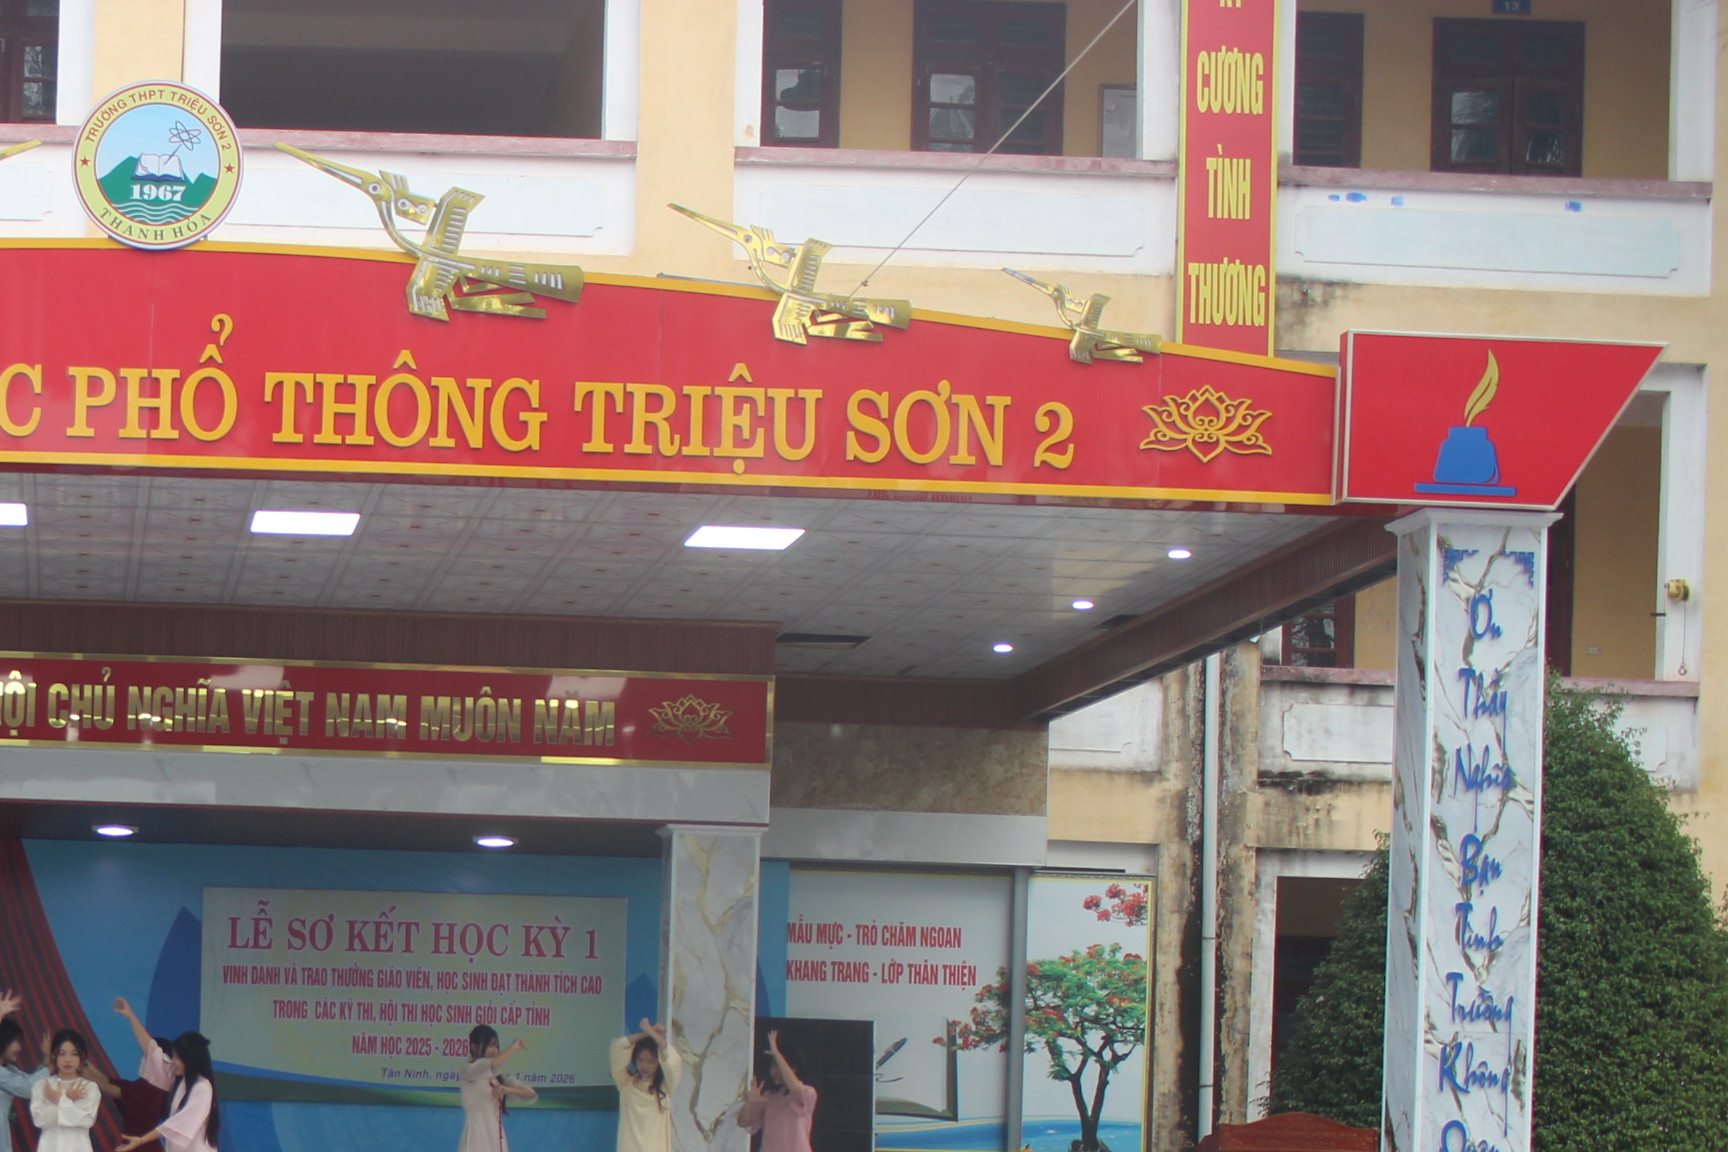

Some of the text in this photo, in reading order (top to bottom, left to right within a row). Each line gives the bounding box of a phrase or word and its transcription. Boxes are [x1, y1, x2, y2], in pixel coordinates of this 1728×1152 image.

[1196, 45, 1264, 115] CƯƠNG
[85, 89, 232, 151] TRƯỜNG THPT TRIỆU SƠN 2
[129, 183, 187, 201] 1967
[1206, 143, 1251, 220] TÌNH
[99, 207, 165, 240] THANH
[1188, 257, 1266, 327] THƯƠNG
[66, 313, 239, 442] PHỔ
[263, 349, 549, 452] THÔNG
[574, 362, 823, 474] TRIỆU
[845, 379, 1012, 467] SƠN
[1033, 401, 1075, 470] 2
[48, 666, 116, 730] CHỦ
[127, 677, 231, 734] NGHĨA
[241, 678, 315, 745] VIỆT
[325, 692, 407, 739] NAM
[419, 686, 522, 743] MUÔN
[533, 689, 617, 746] NĂM
[1459, 833, 1503, 896] Bạn
[227, 900, 599, 964] LỄ SƠ KẾT HỌC KỲ 1
[787, 914, 813, 944] MẪU
[817, 921, 844, 949] MỰC
[855, 919, 878, 945] TRÒ
[882, 921, 916, 947] CHĂM
[920, 926, 962, 948] NGOAN
[223, 965, 248, 984] VINH
[251, 966, 281, 985] DANH
[284, 962, 298, 986] VÀ
[301, 967, 327, 986] TRAO
[331, 962, 373, 988] THƯỞNG
[377, 965, 402, 989] GIÁO
[436, 970, 458, 994] HỌC
[462, 971, 488, 991] SINH
[491, 973, 512, 996] ĐẠT
[515, 969, 550, 993] THÀNH
[554, 970, 578, 994] TÍCH
[581, 975, 602, 995] CAO
[786, 959, 827, 982] KHANG
[831, 961, 870, 983] TRANG
[881, 958, 904, 984] LỚP
[907, 959, 938, 985] THÂN
[942, 960, 977, 990] THIỆN
[273, 1000, 308, 1019] TRONG
[314, 997, 336, 1020] CÁC
[380, 999, 398, 1026] HỘI
[401, 1003, 417, 1022] THI
[421, 1004, 443, 1027] HỌC
[446, 1005, 472, 1024] SINH
[475, 1000, 497, 1025] GIỎI
[500, 1000, 522, 1025] CẤP
[352, 1032, 377, 1054] NĂM
[381, 1036, 402, 1059] HỌC
[405, 1037, 432, 1056] 2025
[442, 1038, 469, 1057] 2026
[381, 1067, 400, 1078] Tân
[550, 1073, 576, 1084] 2026
[1438, 1041, 1512, 1138] Không
